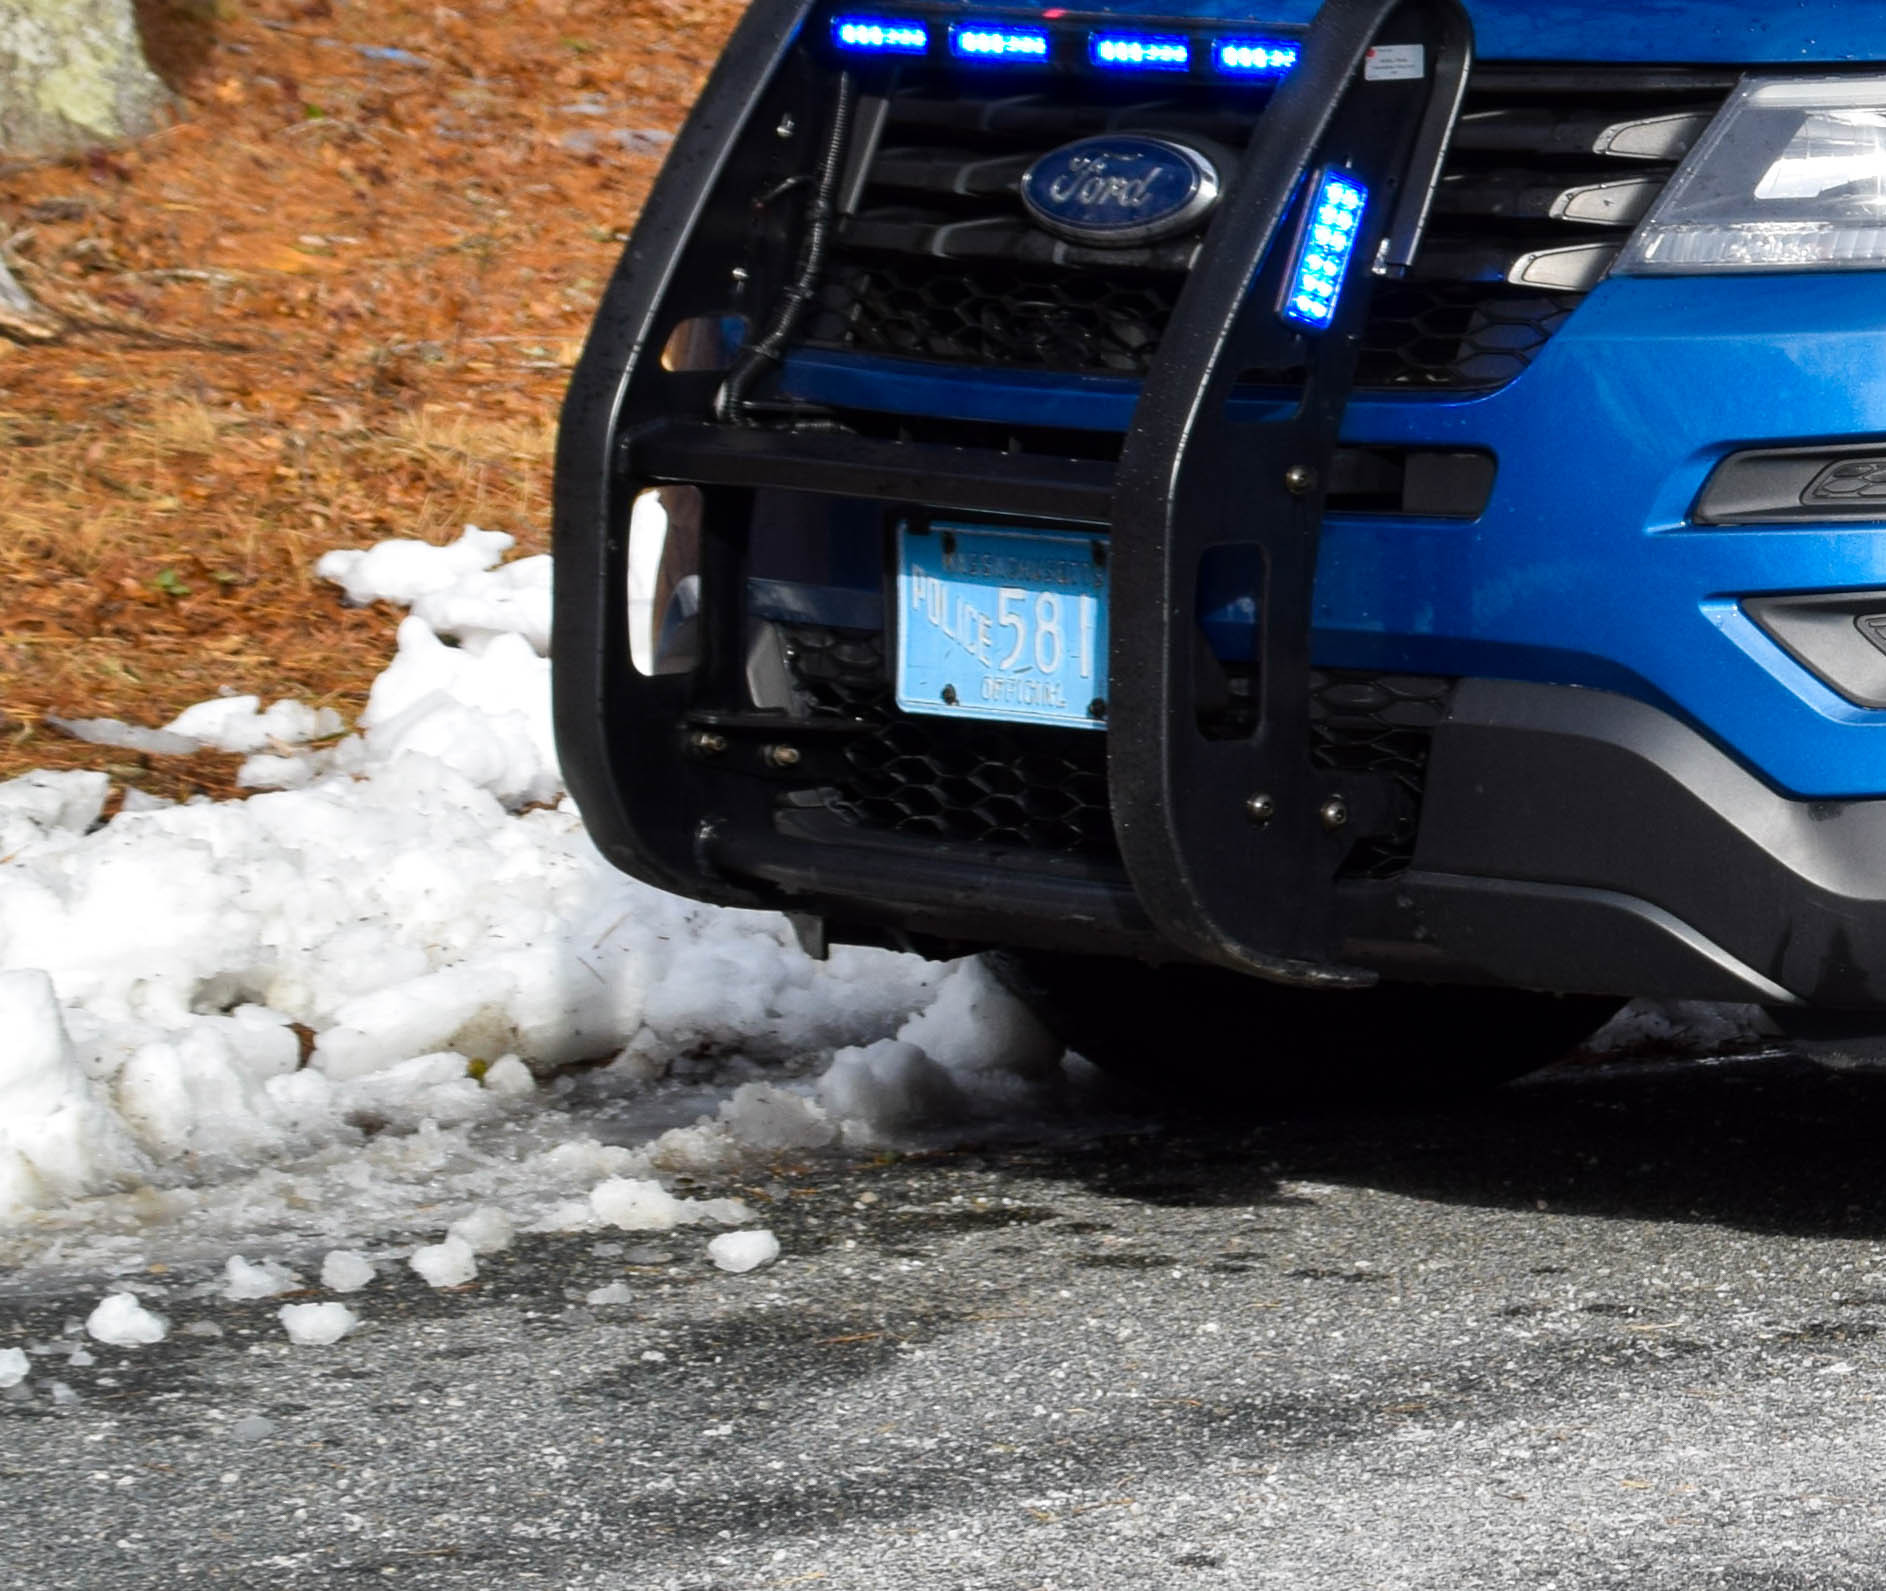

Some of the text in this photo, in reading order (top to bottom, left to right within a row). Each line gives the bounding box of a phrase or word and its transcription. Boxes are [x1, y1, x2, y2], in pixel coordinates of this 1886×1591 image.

[1050, 152, 1163, 207] Ford
[911, 563, 1093, 679] POLICE 581
